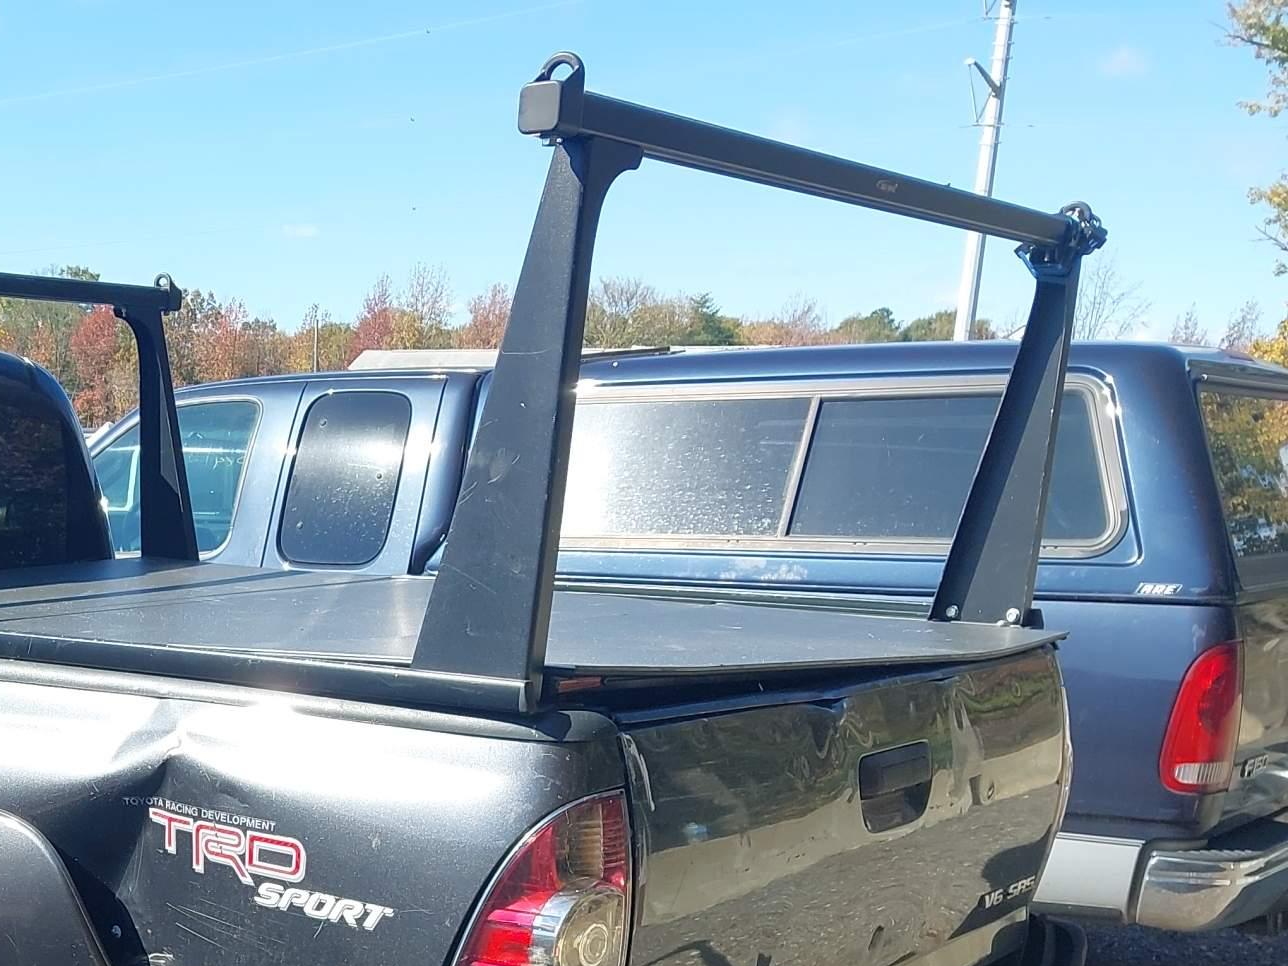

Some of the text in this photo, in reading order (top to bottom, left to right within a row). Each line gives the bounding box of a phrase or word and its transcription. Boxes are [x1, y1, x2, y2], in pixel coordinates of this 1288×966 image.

[123, 797, 277, 832] TOYOTA RACING DEVELOPMENT
[149, 807, 306, 886] TRD
[254, 882, 395, 930] SPORT
[984, 888, 1004, 909] V6
